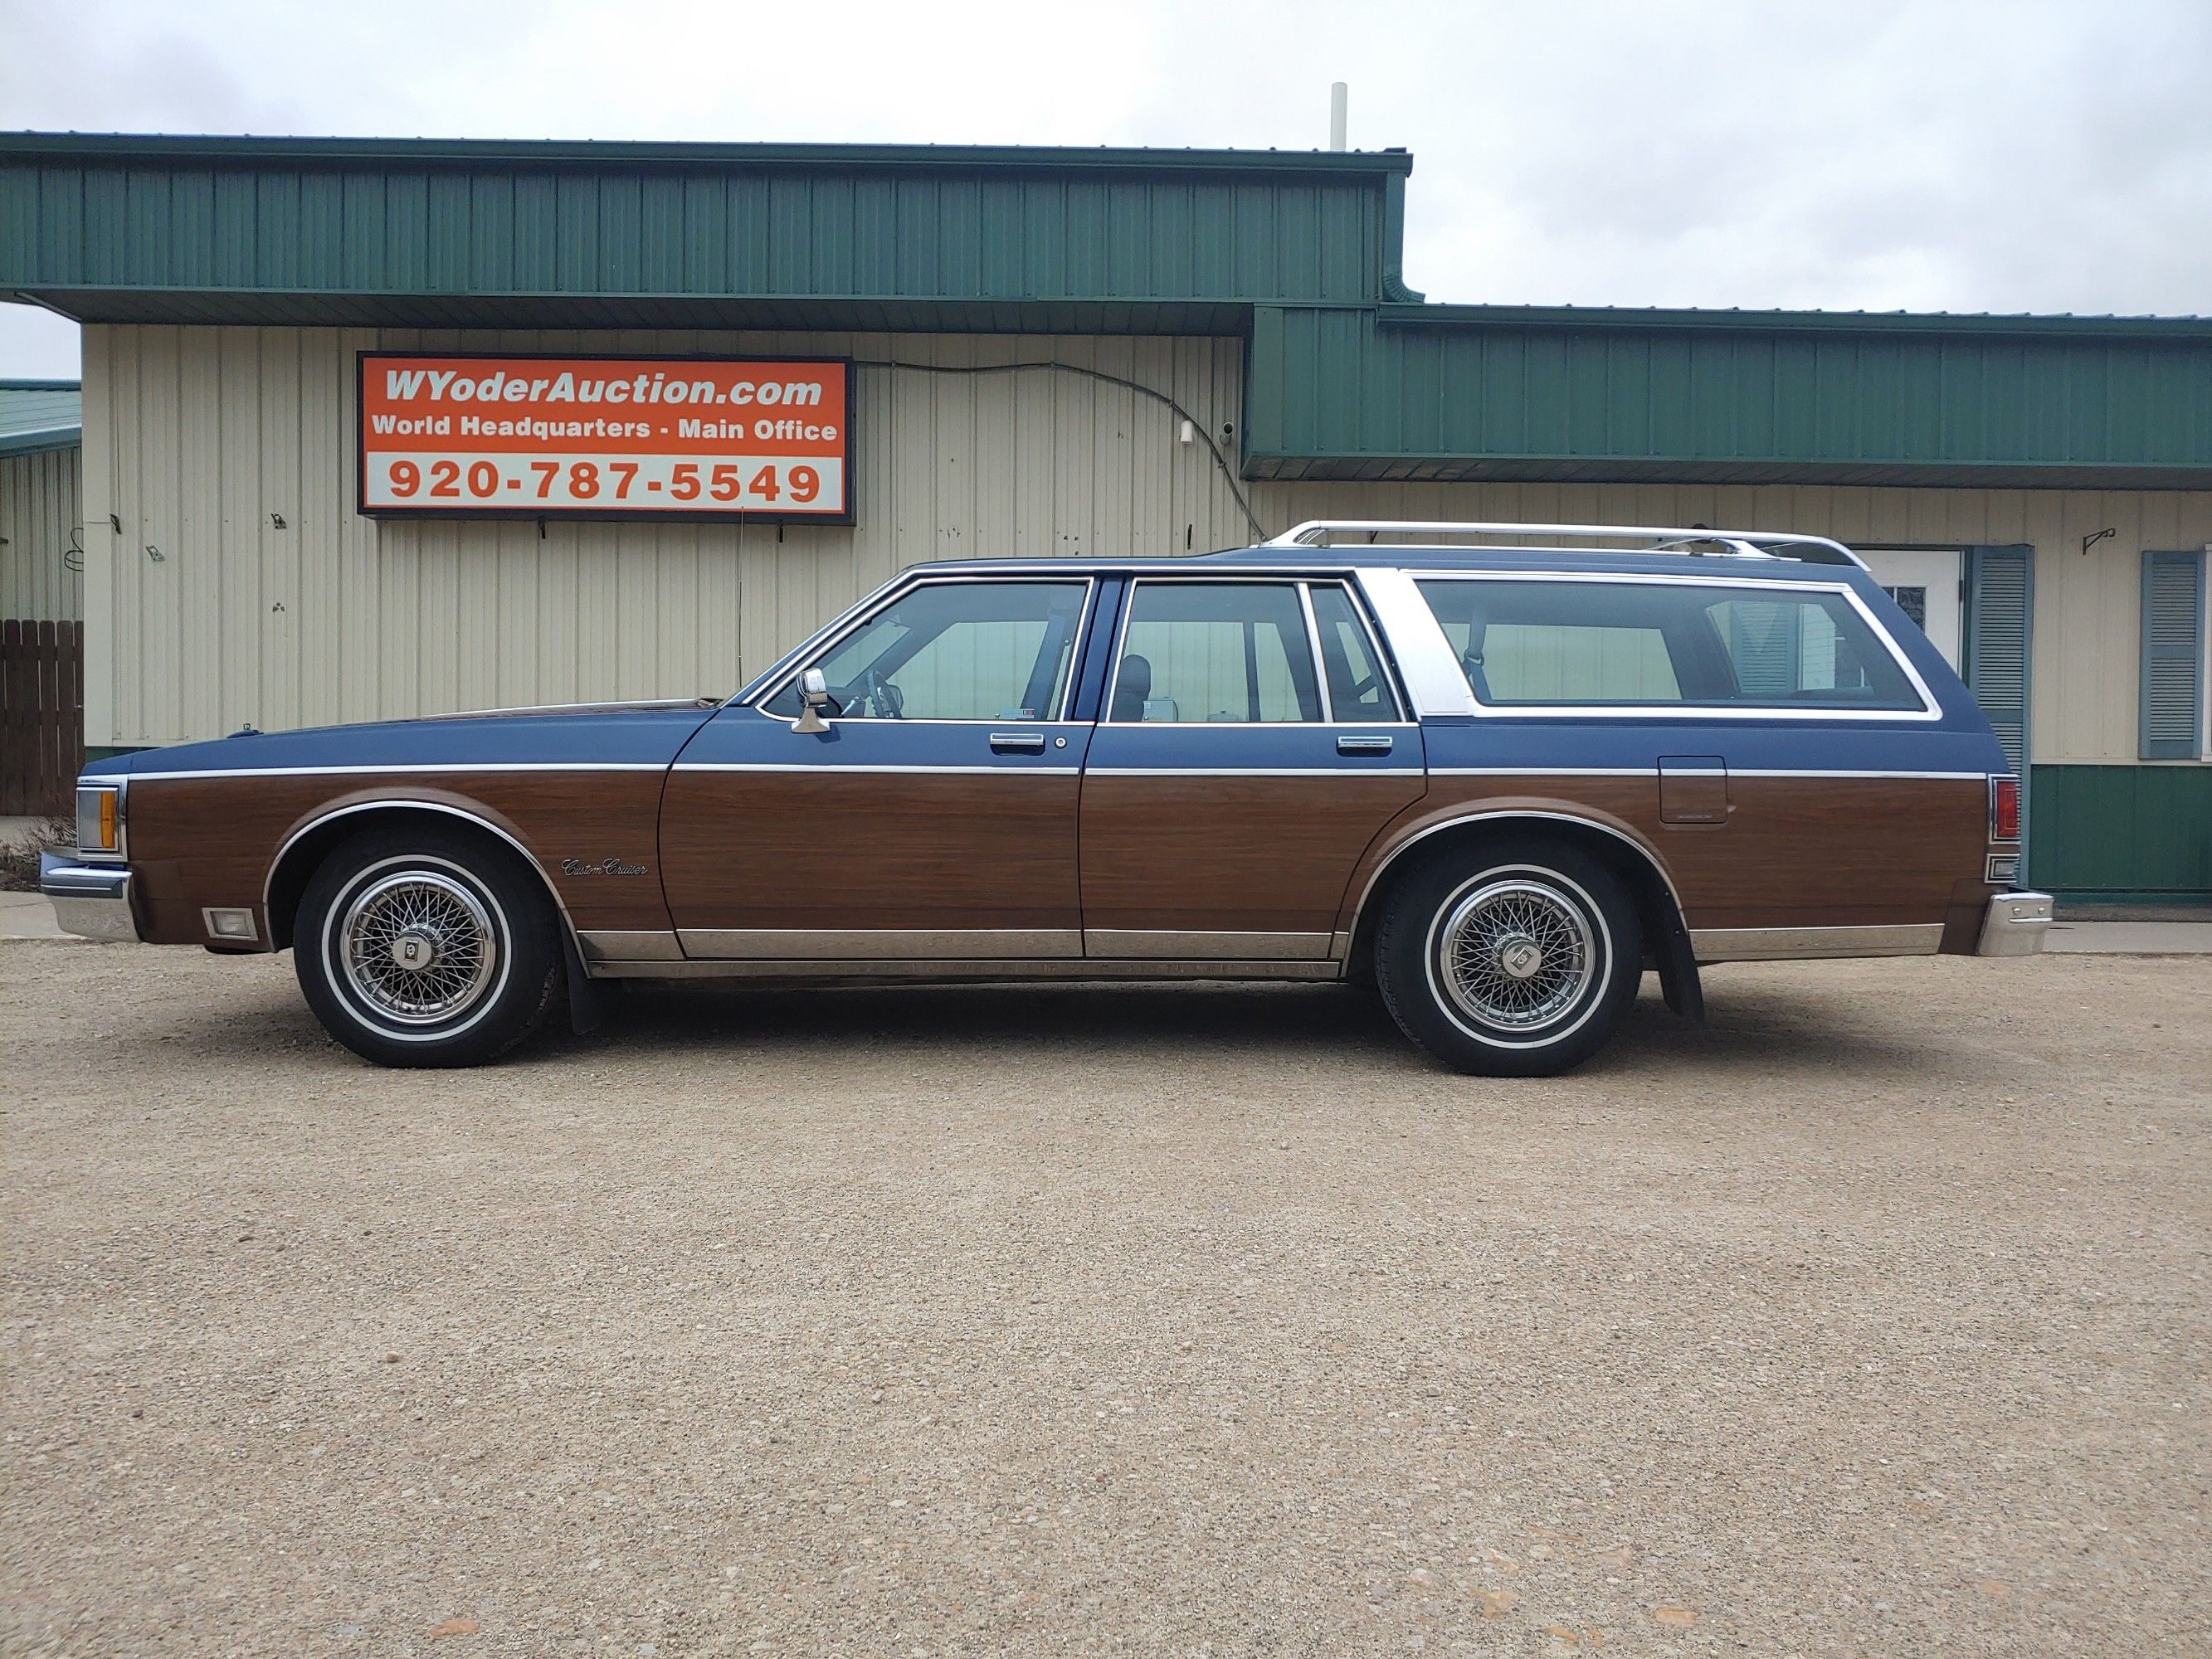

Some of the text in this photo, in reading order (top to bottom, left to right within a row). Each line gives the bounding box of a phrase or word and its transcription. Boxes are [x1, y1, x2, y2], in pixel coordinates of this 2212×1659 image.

[386, 370, 822, 406] WYoderAuction.com
[372, 415, 451, 435] World
[460, 416, 650, 440] Headquarters
[679, 418, 744, 439] Main
[754, 420, 837, 440] Office
[388, 460, 820, 504] 920-787-5549
[562, 858, 648, 876] Custom Cruiser
